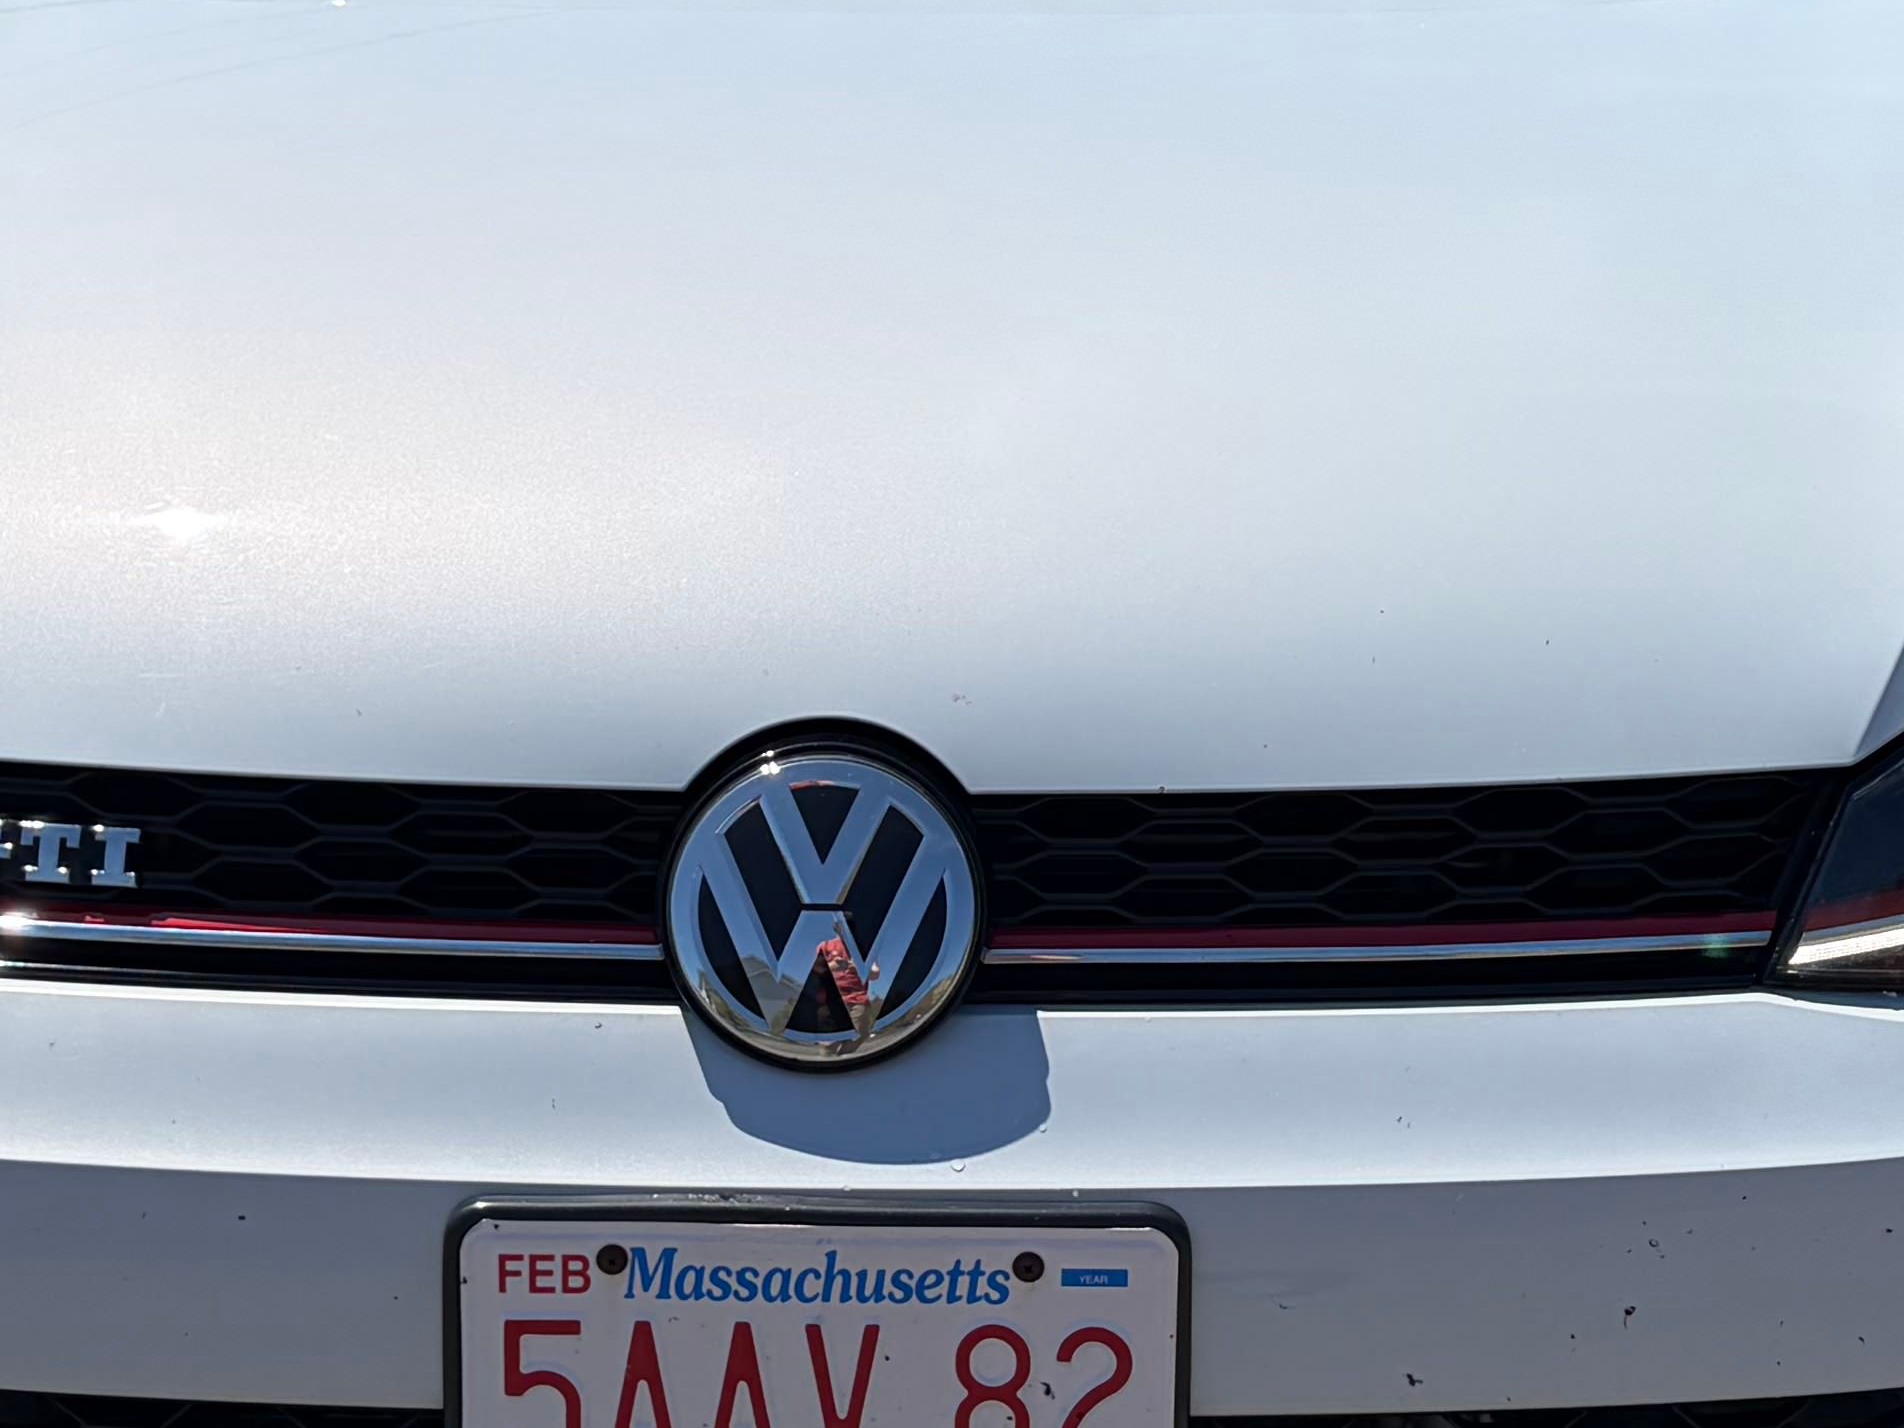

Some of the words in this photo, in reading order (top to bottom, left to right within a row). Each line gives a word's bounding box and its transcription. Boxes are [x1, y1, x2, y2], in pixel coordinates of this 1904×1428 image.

[498, 1253, 592, 1294] FEB
[623, 1246, 1011, 1306] Massachusetts
[1078, 1275, 1109, 1286] YEAR
